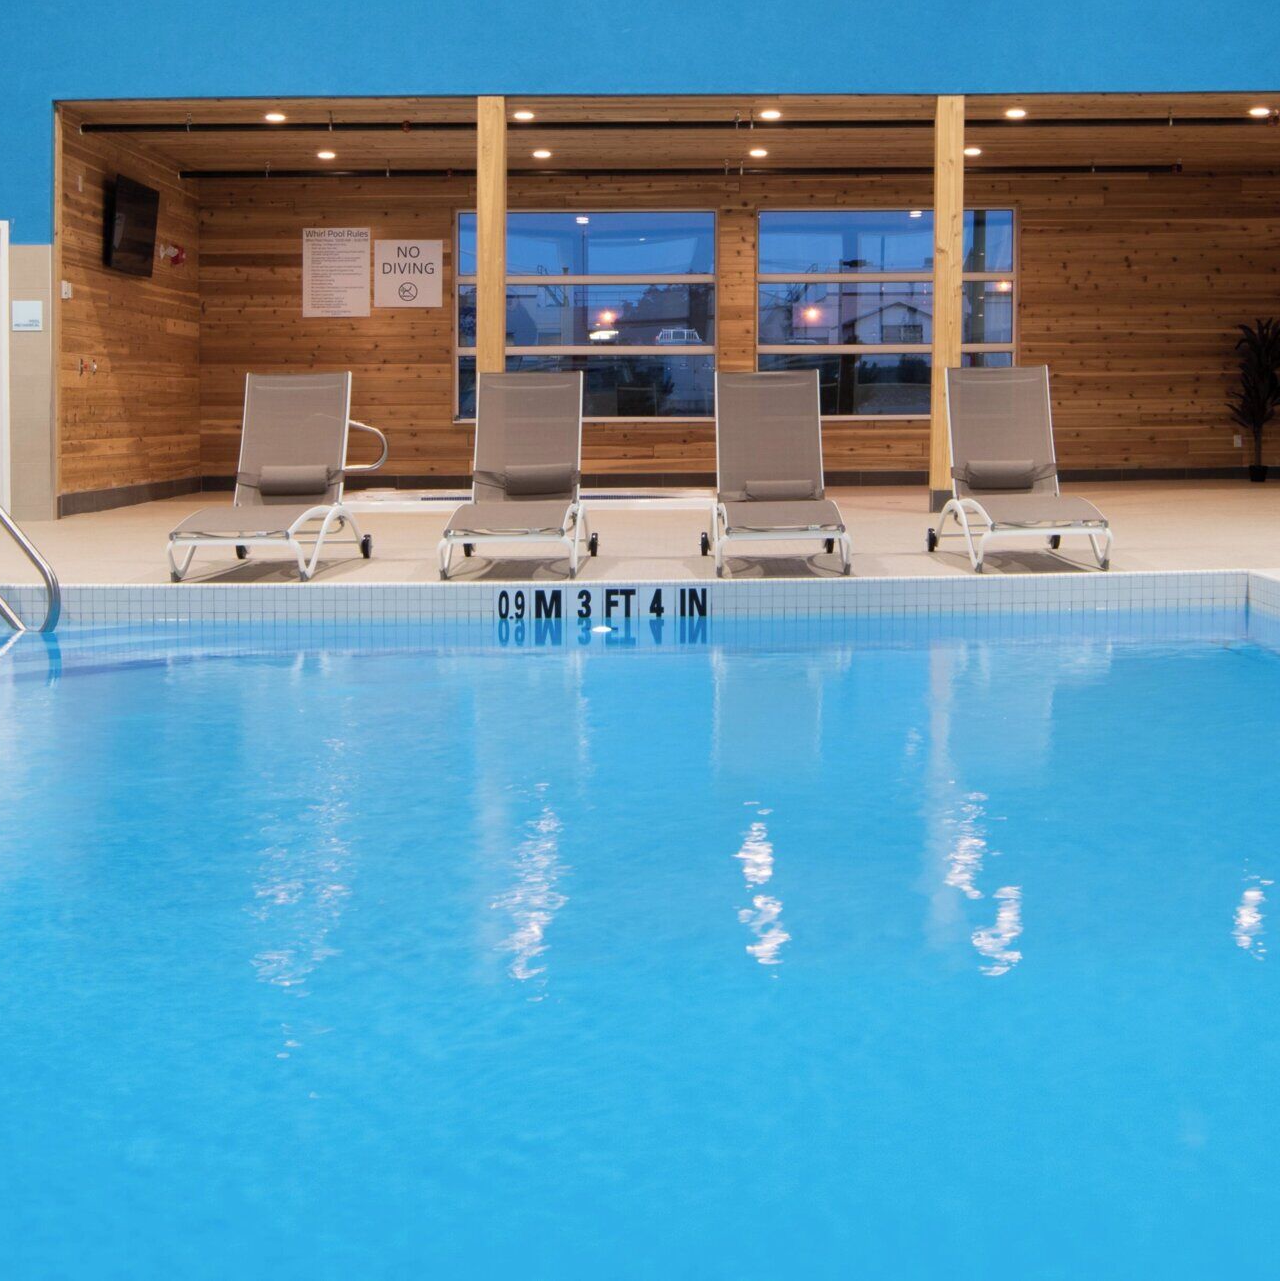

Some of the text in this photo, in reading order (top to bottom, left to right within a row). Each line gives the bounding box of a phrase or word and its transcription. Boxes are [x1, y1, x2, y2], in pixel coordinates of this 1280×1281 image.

[305, 230, 369, 238] Whirl Pool Rules
[397, 246, 420, 258] NO
[382, 262, 435, 275] DIVING
[498, 588, 707, 620] 0.9 M 3 FT 4 IN
